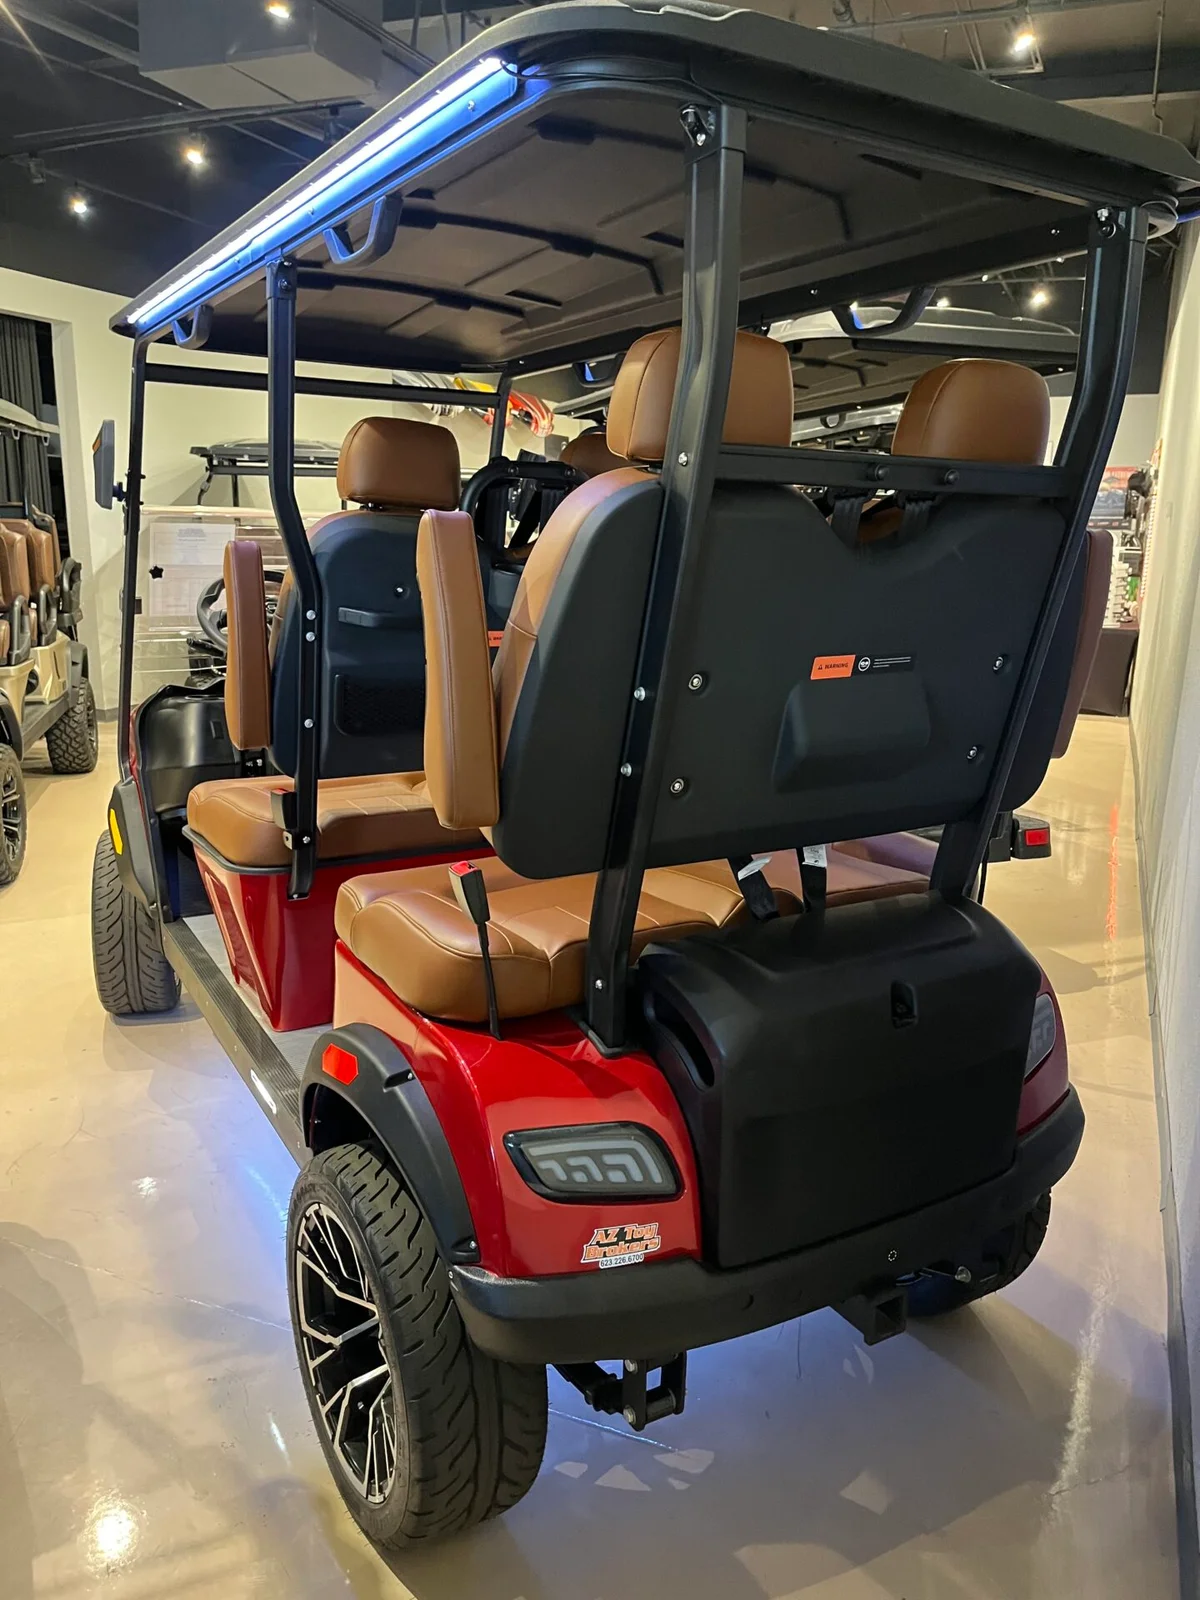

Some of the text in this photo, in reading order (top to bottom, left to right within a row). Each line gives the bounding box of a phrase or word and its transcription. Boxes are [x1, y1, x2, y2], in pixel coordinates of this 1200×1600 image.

[824, 662, 849, 670] WARNING
[592, 1225, 656, 1244] AZ Toy
[585, 1239, 659, 1259] Brokers
[600, 1253, 644, 1267] 623.226.6700
